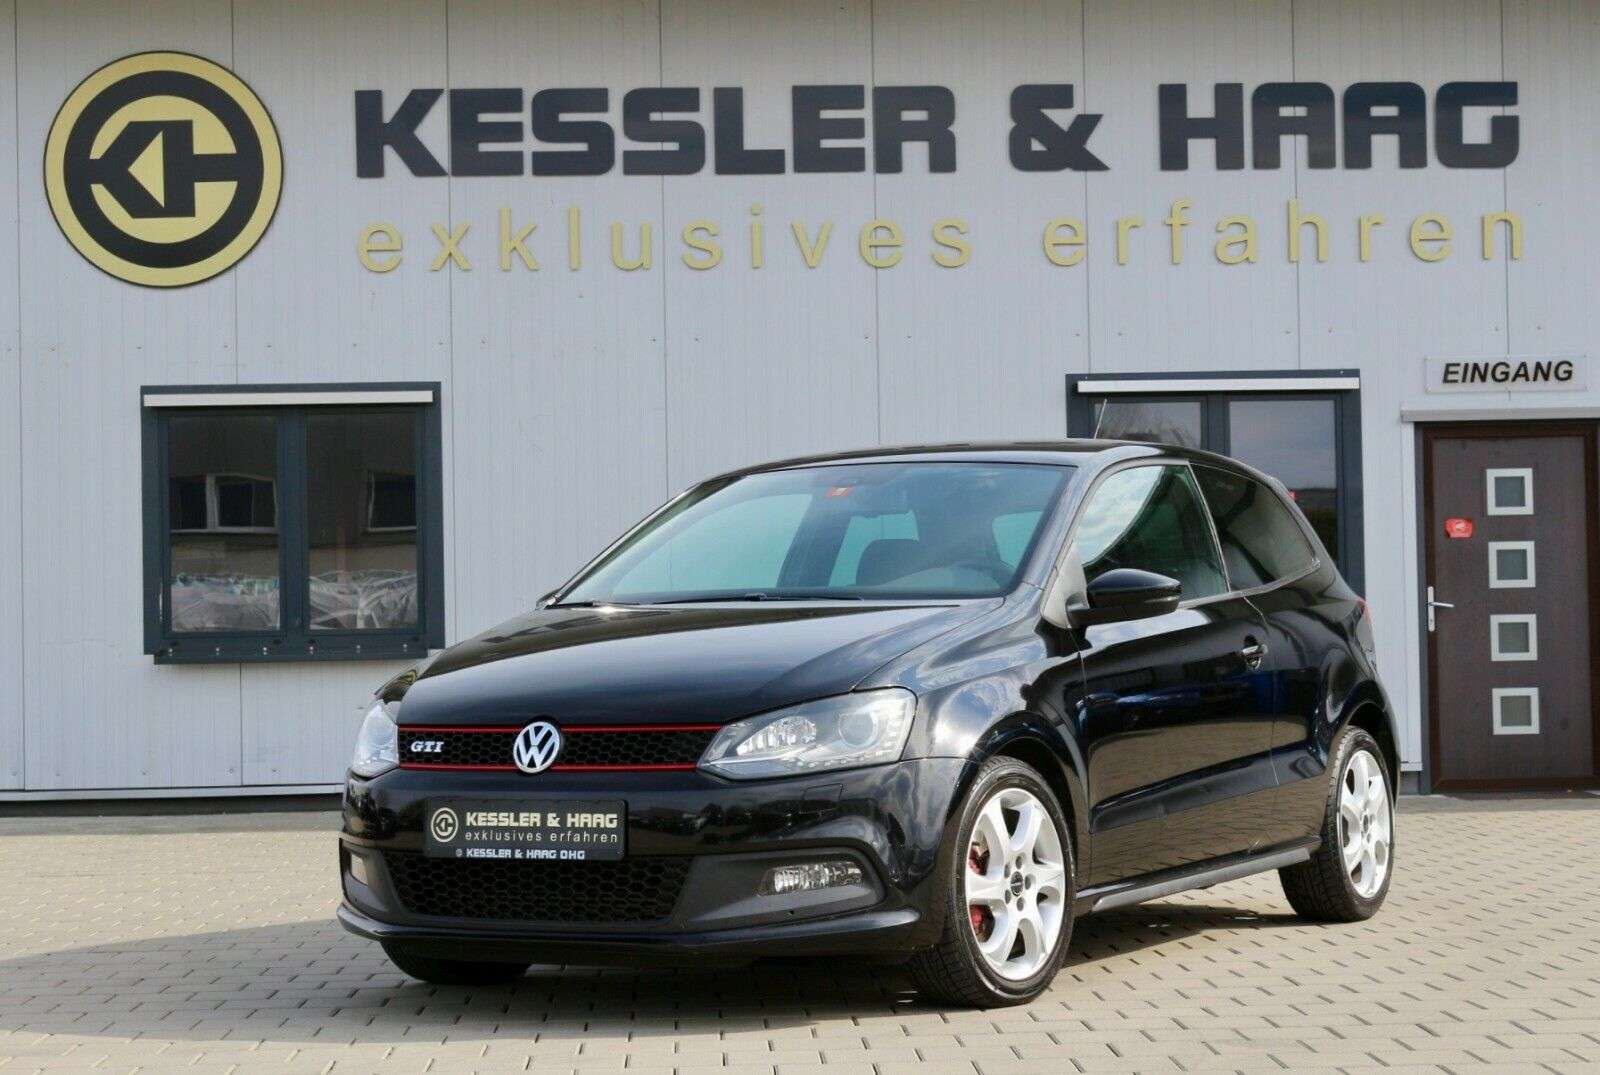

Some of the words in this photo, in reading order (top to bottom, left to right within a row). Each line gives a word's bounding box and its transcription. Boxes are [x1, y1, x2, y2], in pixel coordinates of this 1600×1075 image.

[354, 85, 956, 178] KESSLER
[1009, 84, 1110, 172] &
[1158, 81, 1520, 171] HAAG
[357, 204, 972, 272] exklusives
[1042, 199, 1524, 268] erfahren
[1442, 360, 1574, 384] EINGANG
[410, 740, 445, 753] GTI
[465, 811, 541, 828] KESSLER
[546, 812, 561, 828] &
[566, 812, 618, 829] HAAG
[464, 830, 543, 842] exklusives
[550, 830, 618, 843] erfahren
[466, 848, 512, 858] KESSLER
[526, 849, 556, 860] HAAG
